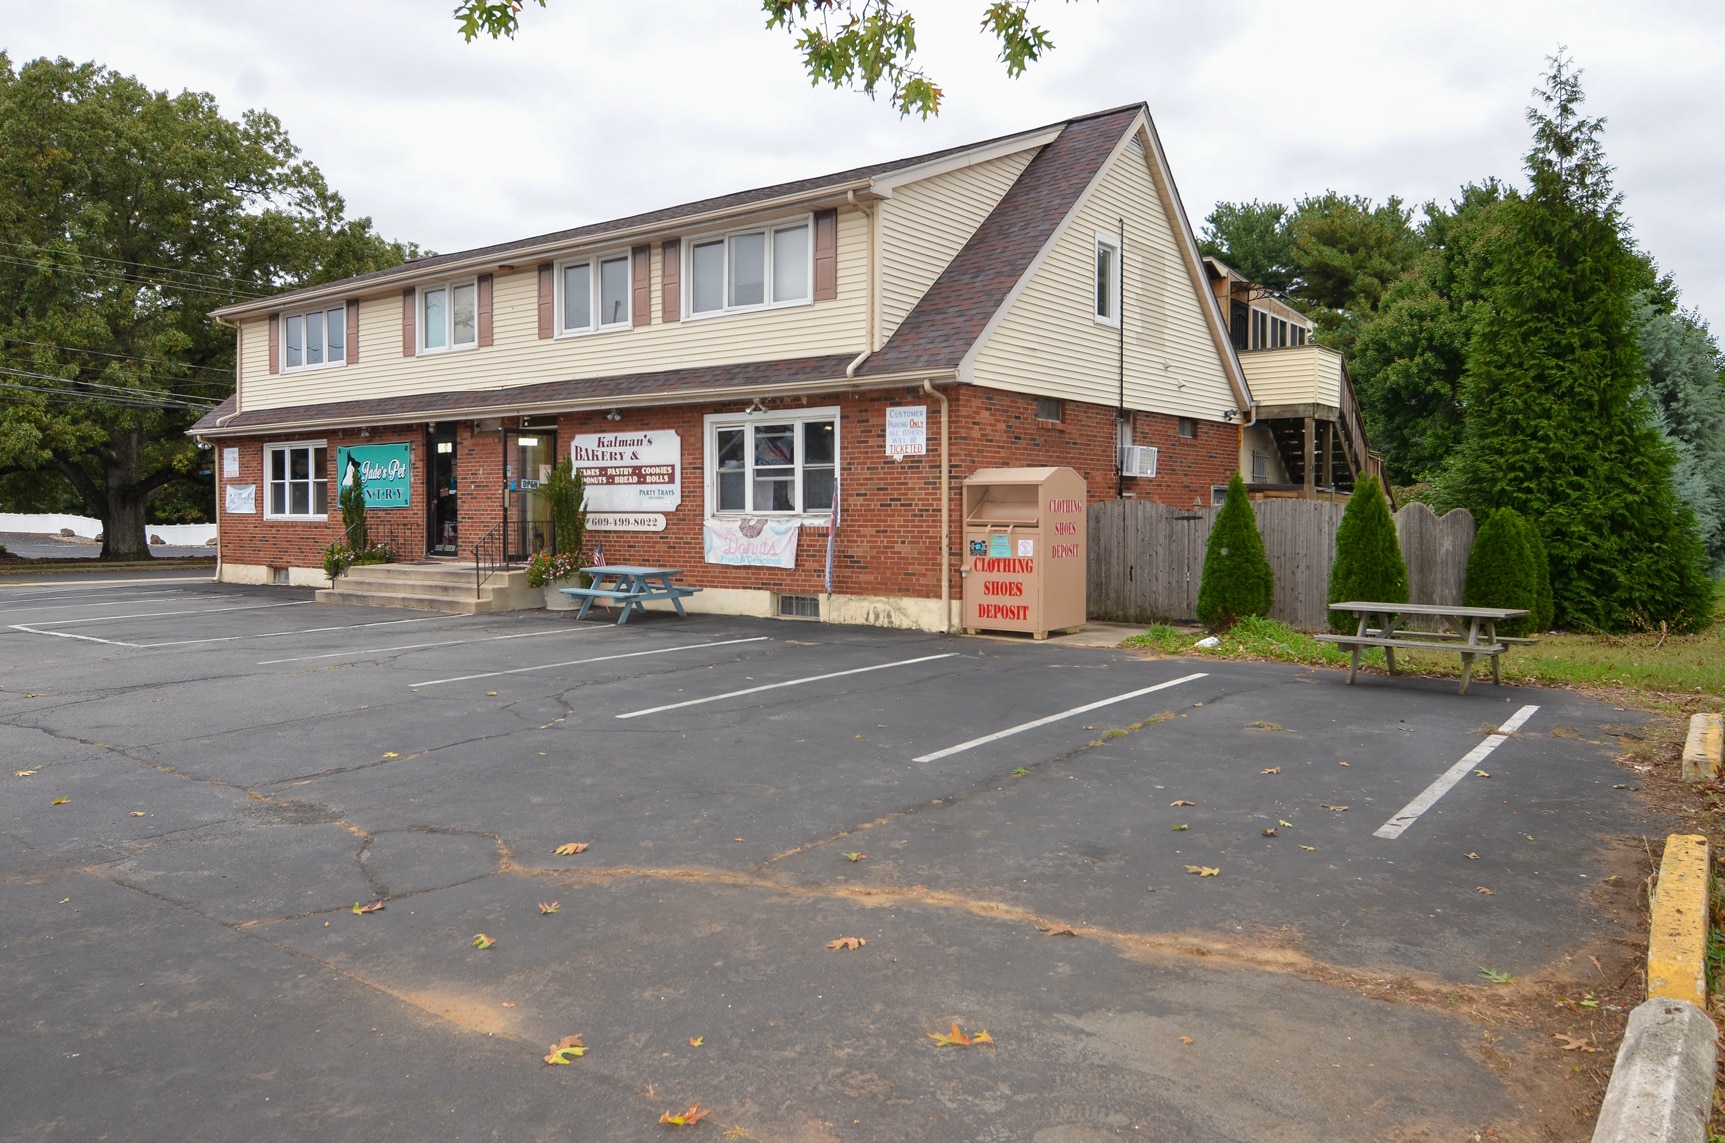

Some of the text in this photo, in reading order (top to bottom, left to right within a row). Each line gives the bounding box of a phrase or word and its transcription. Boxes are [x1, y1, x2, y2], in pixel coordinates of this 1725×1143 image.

[889, 409, 924, 418] CUSTOMER
[888, 418, 924, 428] PARKING ONLY
[902, 429, 923, 437] OTHERS
[597, 434, 653, 448] Kalman's
[574, 445, 640, 462] BAKERY &
[889, 444, 922, 454] TICKETED
[361, 458, 406, 483] Jade's Pet
[607, 467, 633, 475] PASTRY
[641, 466, 672, 474] COOKIES
[614, 476, 638, 484] BREAD
[646, 475, 669, 483] ROLLS
[1049, 499, 1082, 513] CLOTHING
[591, 517, 658, 527] 609-499-8022
[1055, 522, 1076, 535] SHOES
[724, 534, 778, 555] Donuts
[1052, 544, 1079, 558] DEPOSIT
[720, 555, 739, 563] Fresh
[747, 556, 781, 565] Delicious
[974, 557, 1034, 574] CLOTHING
[983, 581, 1023, 597] SHOES
[978, 603, 1029, 620] DEPOSIT
